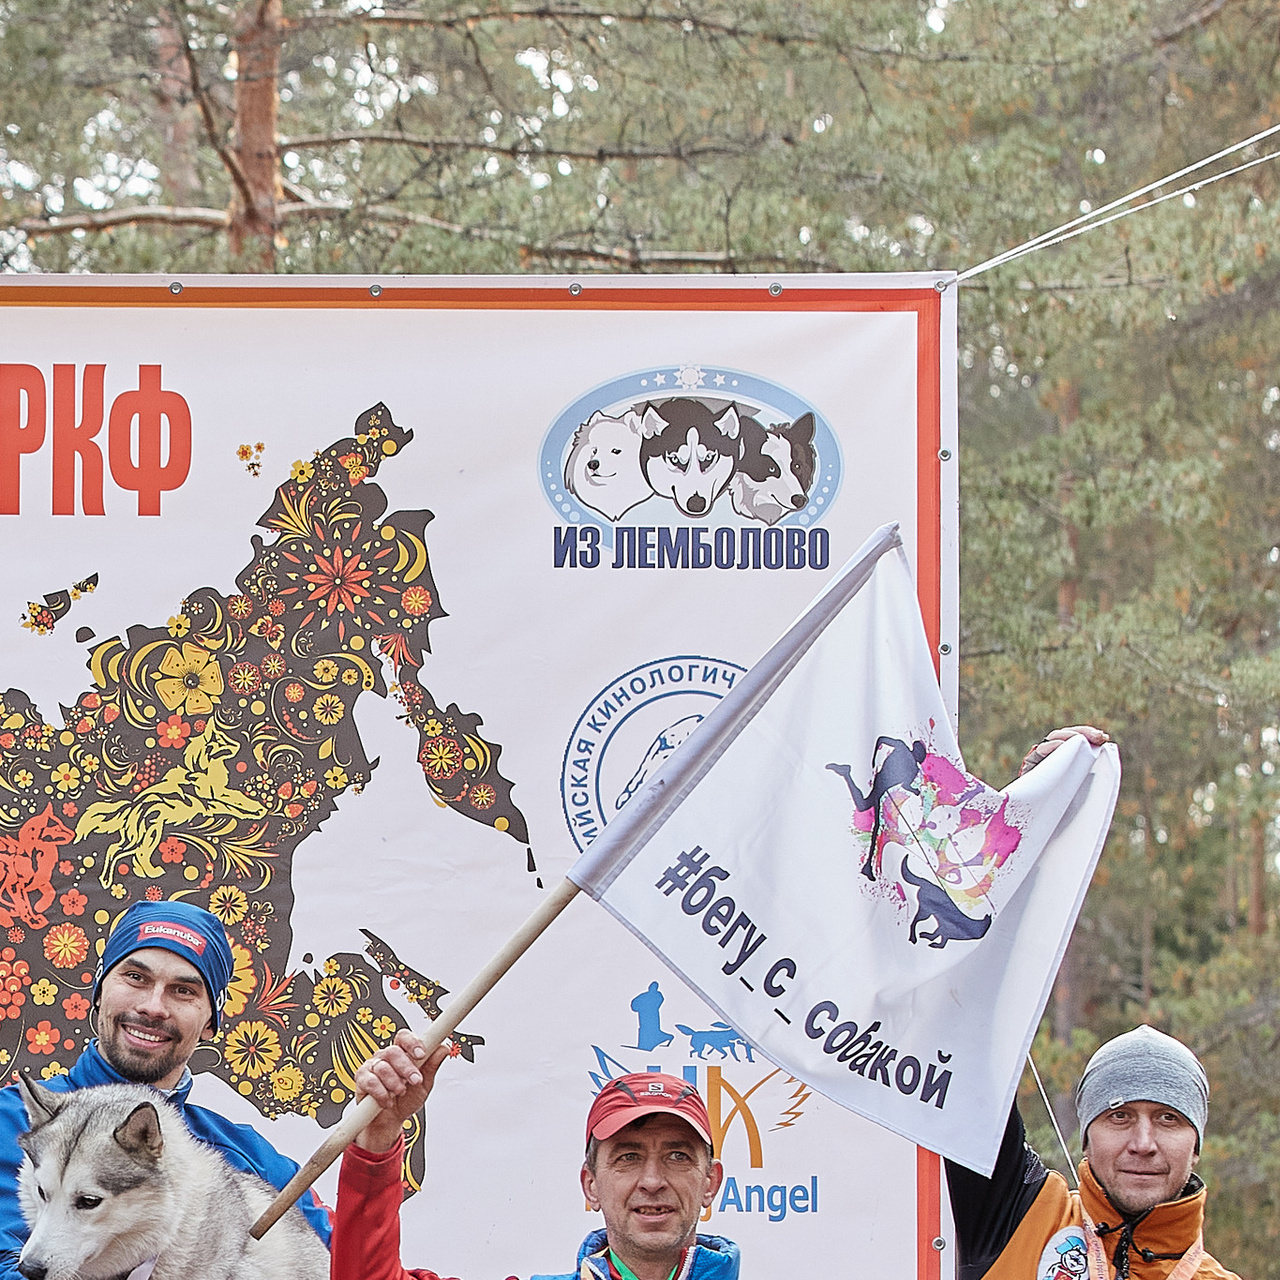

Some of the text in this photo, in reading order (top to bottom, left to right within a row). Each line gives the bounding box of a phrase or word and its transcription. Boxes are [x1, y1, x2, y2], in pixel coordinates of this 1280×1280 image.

[553, 526, 830, 570] ИЗ ЛЕМБОЛОВО
[587, 664, 736, 733] КИНОЛОГИЧ
[144, 925, 202, 947] Eukanuba
[718, 1176, 818, 1222] Angel
